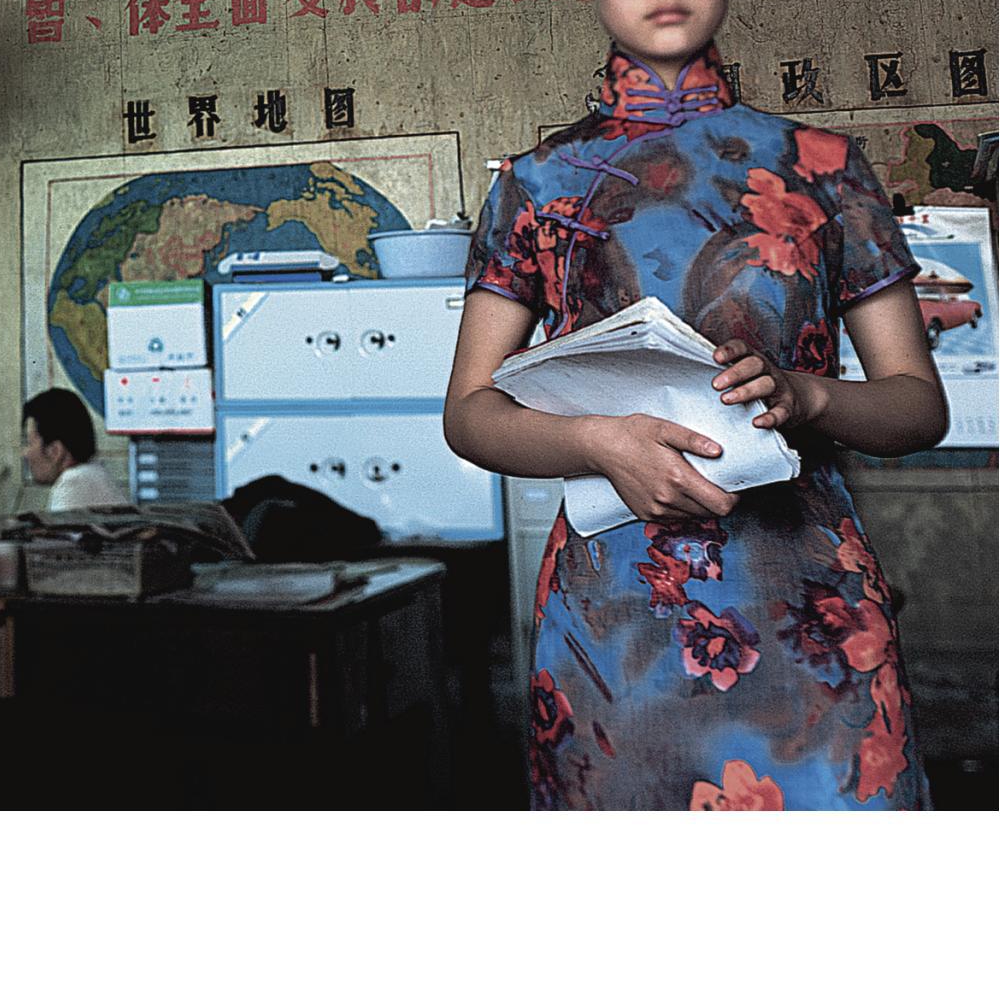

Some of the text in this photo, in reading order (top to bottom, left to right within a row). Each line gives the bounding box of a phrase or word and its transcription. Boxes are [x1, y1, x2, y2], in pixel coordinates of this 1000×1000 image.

[719, 47, 989, 104] 政区图
[122, 87, 356, 145] 世界地图
